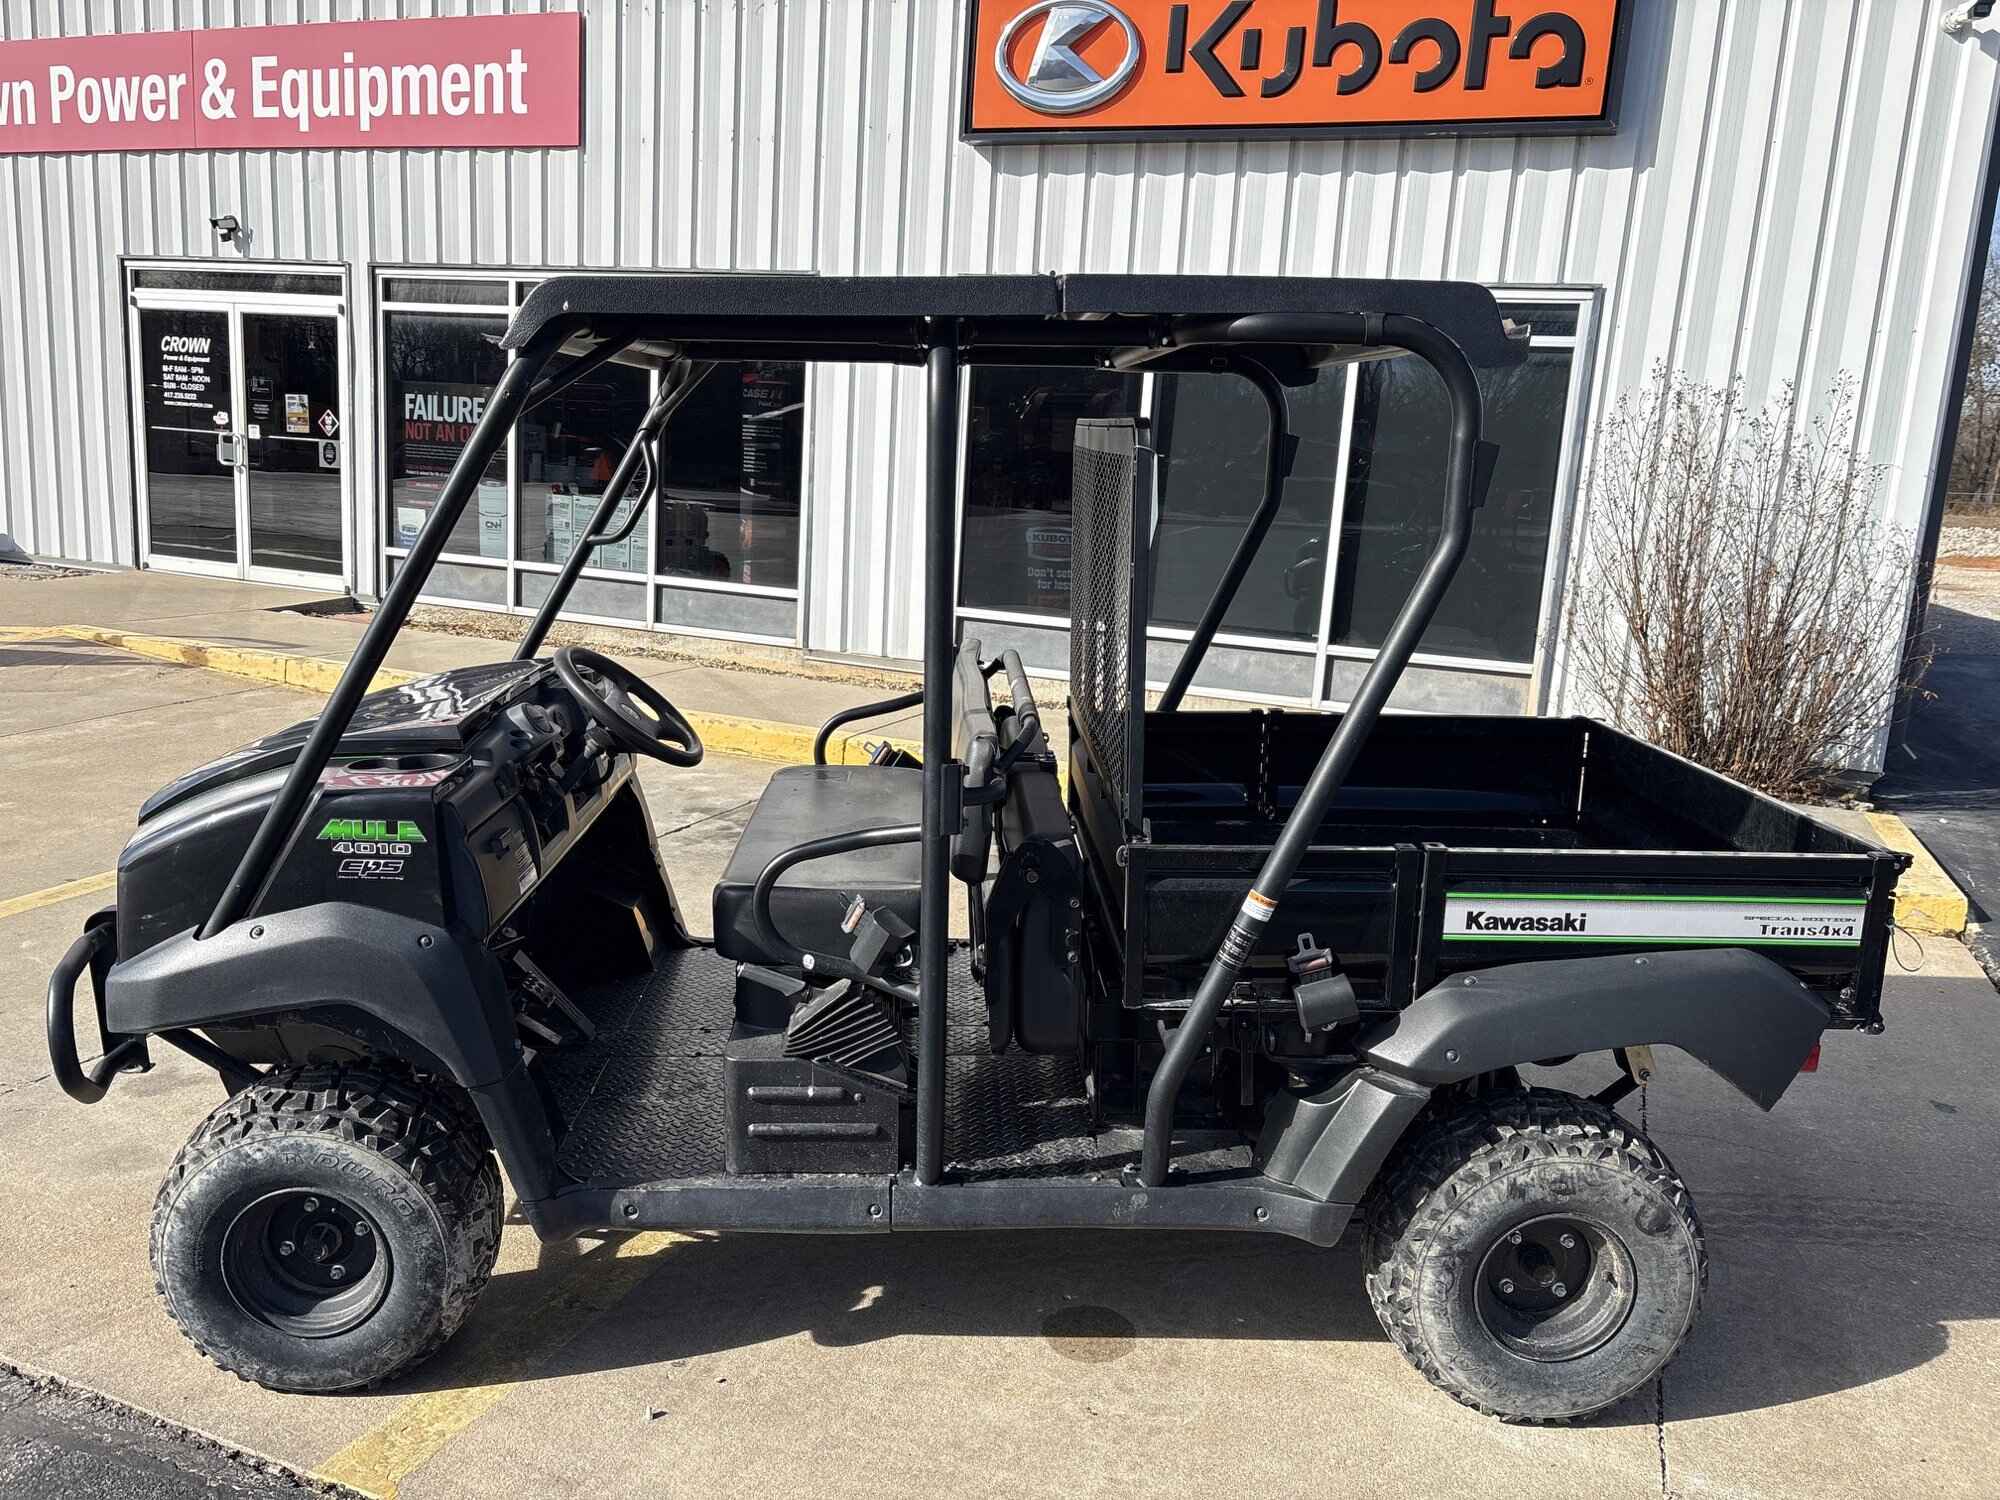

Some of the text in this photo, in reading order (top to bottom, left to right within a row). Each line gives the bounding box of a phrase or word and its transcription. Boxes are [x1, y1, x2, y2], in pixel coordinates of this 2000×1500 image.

[1166, 0, 1587, 99] Kubota
[49, 64, 187, 125] Power
[200, 57, 237, 121] &
[251, 48, 528, 132] Equipment
[161, 335, 211, 354] CROWN
[163, 373, 175, 381] SAT
[192, 375, 211, 384] NOON
[180, 382, 205, 392] CLOSED
[405, 393, 485, 424] FAILURE
[405, 422, 431, 441] NOT
[436, 424, 455, 443] AN
[1032, 533, 1072, 543] KUBOT
[1027, 567, 1054, 578] Don't
[316, 819, 427, 843] MULE
[332, 842, 412, 855] 4010
[1465, 910, 1587, 932] Kawasaki
[1760, 924, 1855, 937] Trans4x4
